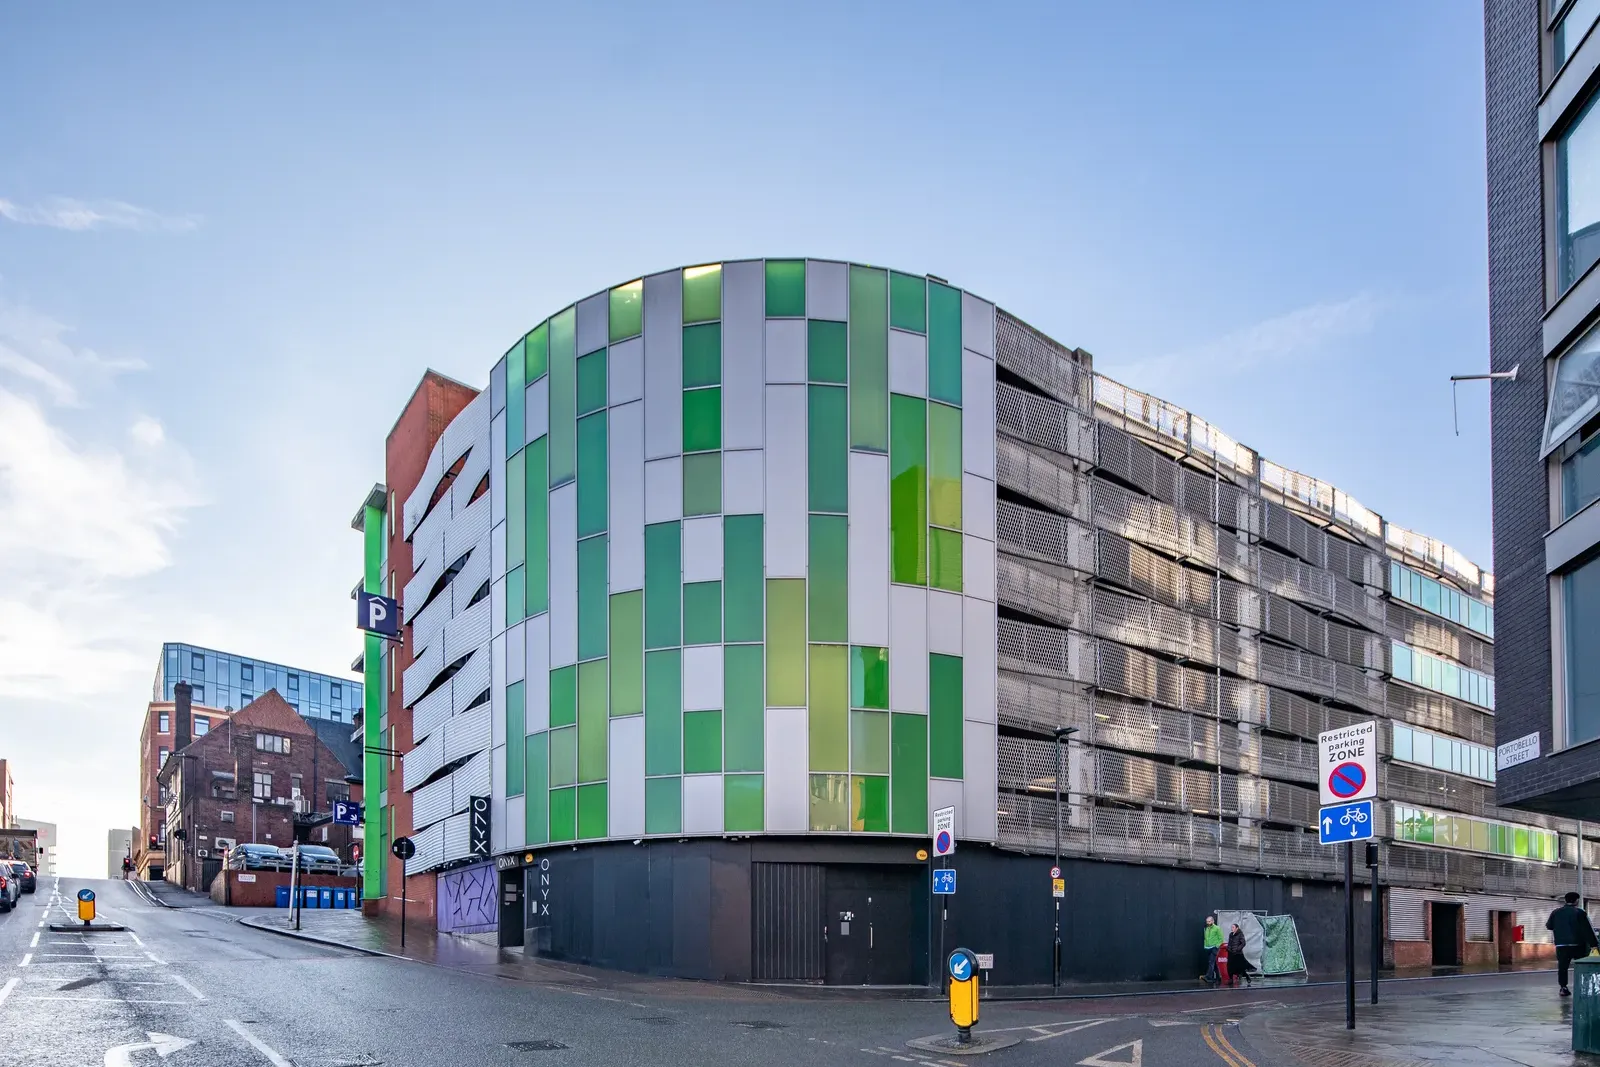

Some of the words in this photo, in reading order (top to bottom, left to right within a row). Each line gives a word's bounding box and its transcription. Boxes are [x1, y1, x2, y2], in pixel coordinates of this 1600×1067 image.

[370, 602, 387, 629] P
[1321, 725, 1373, 743] Restricted
[1329, 738, 1365, 752] parking
[1499, 736, 1538, 757] PORTOBELLO
[1329, 746, 1365, 763] ZONE
[1506, 749, 1530, 765] STREET
[474, 798, 488, 853] ONYX
[937, 822, 951, 831] ZONE
[498, 855, 515, 869] ONYX
[541, 858, 550, 916] ONYX
